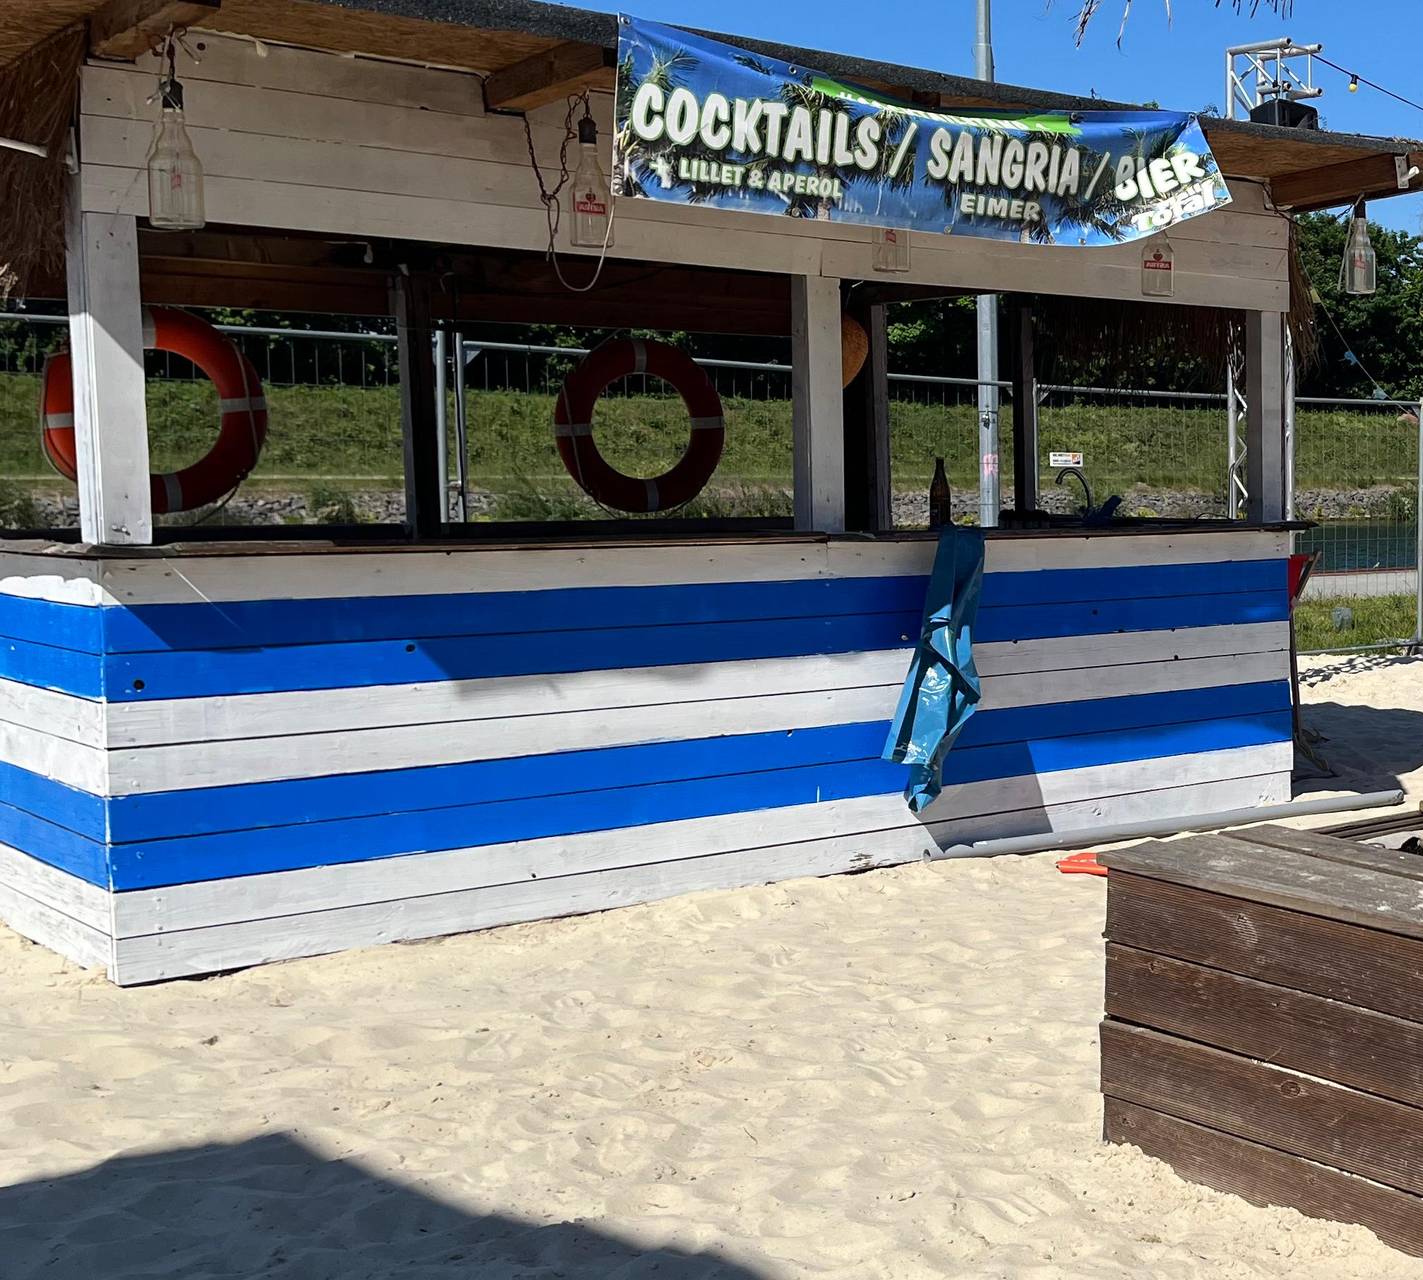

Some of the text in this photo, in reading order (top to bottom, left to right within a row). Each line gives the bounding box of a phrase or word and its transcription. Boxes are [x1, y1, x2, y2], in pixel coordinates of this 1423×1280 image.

[631, 82, 882, 171] COCKTAILS
[888, 122, 918, 178] /
[926, 127, 1082, 198] SANGRIA
[1084, 151, 1111, 200] /
[1115, 152, 1205, 201] BIER
[678, 157, 747, 187] LILLET
[747, 168, 766, 190] &
[766, 170, 844, 199] APEROL
[959, 192, 1041, 221] EIMER
